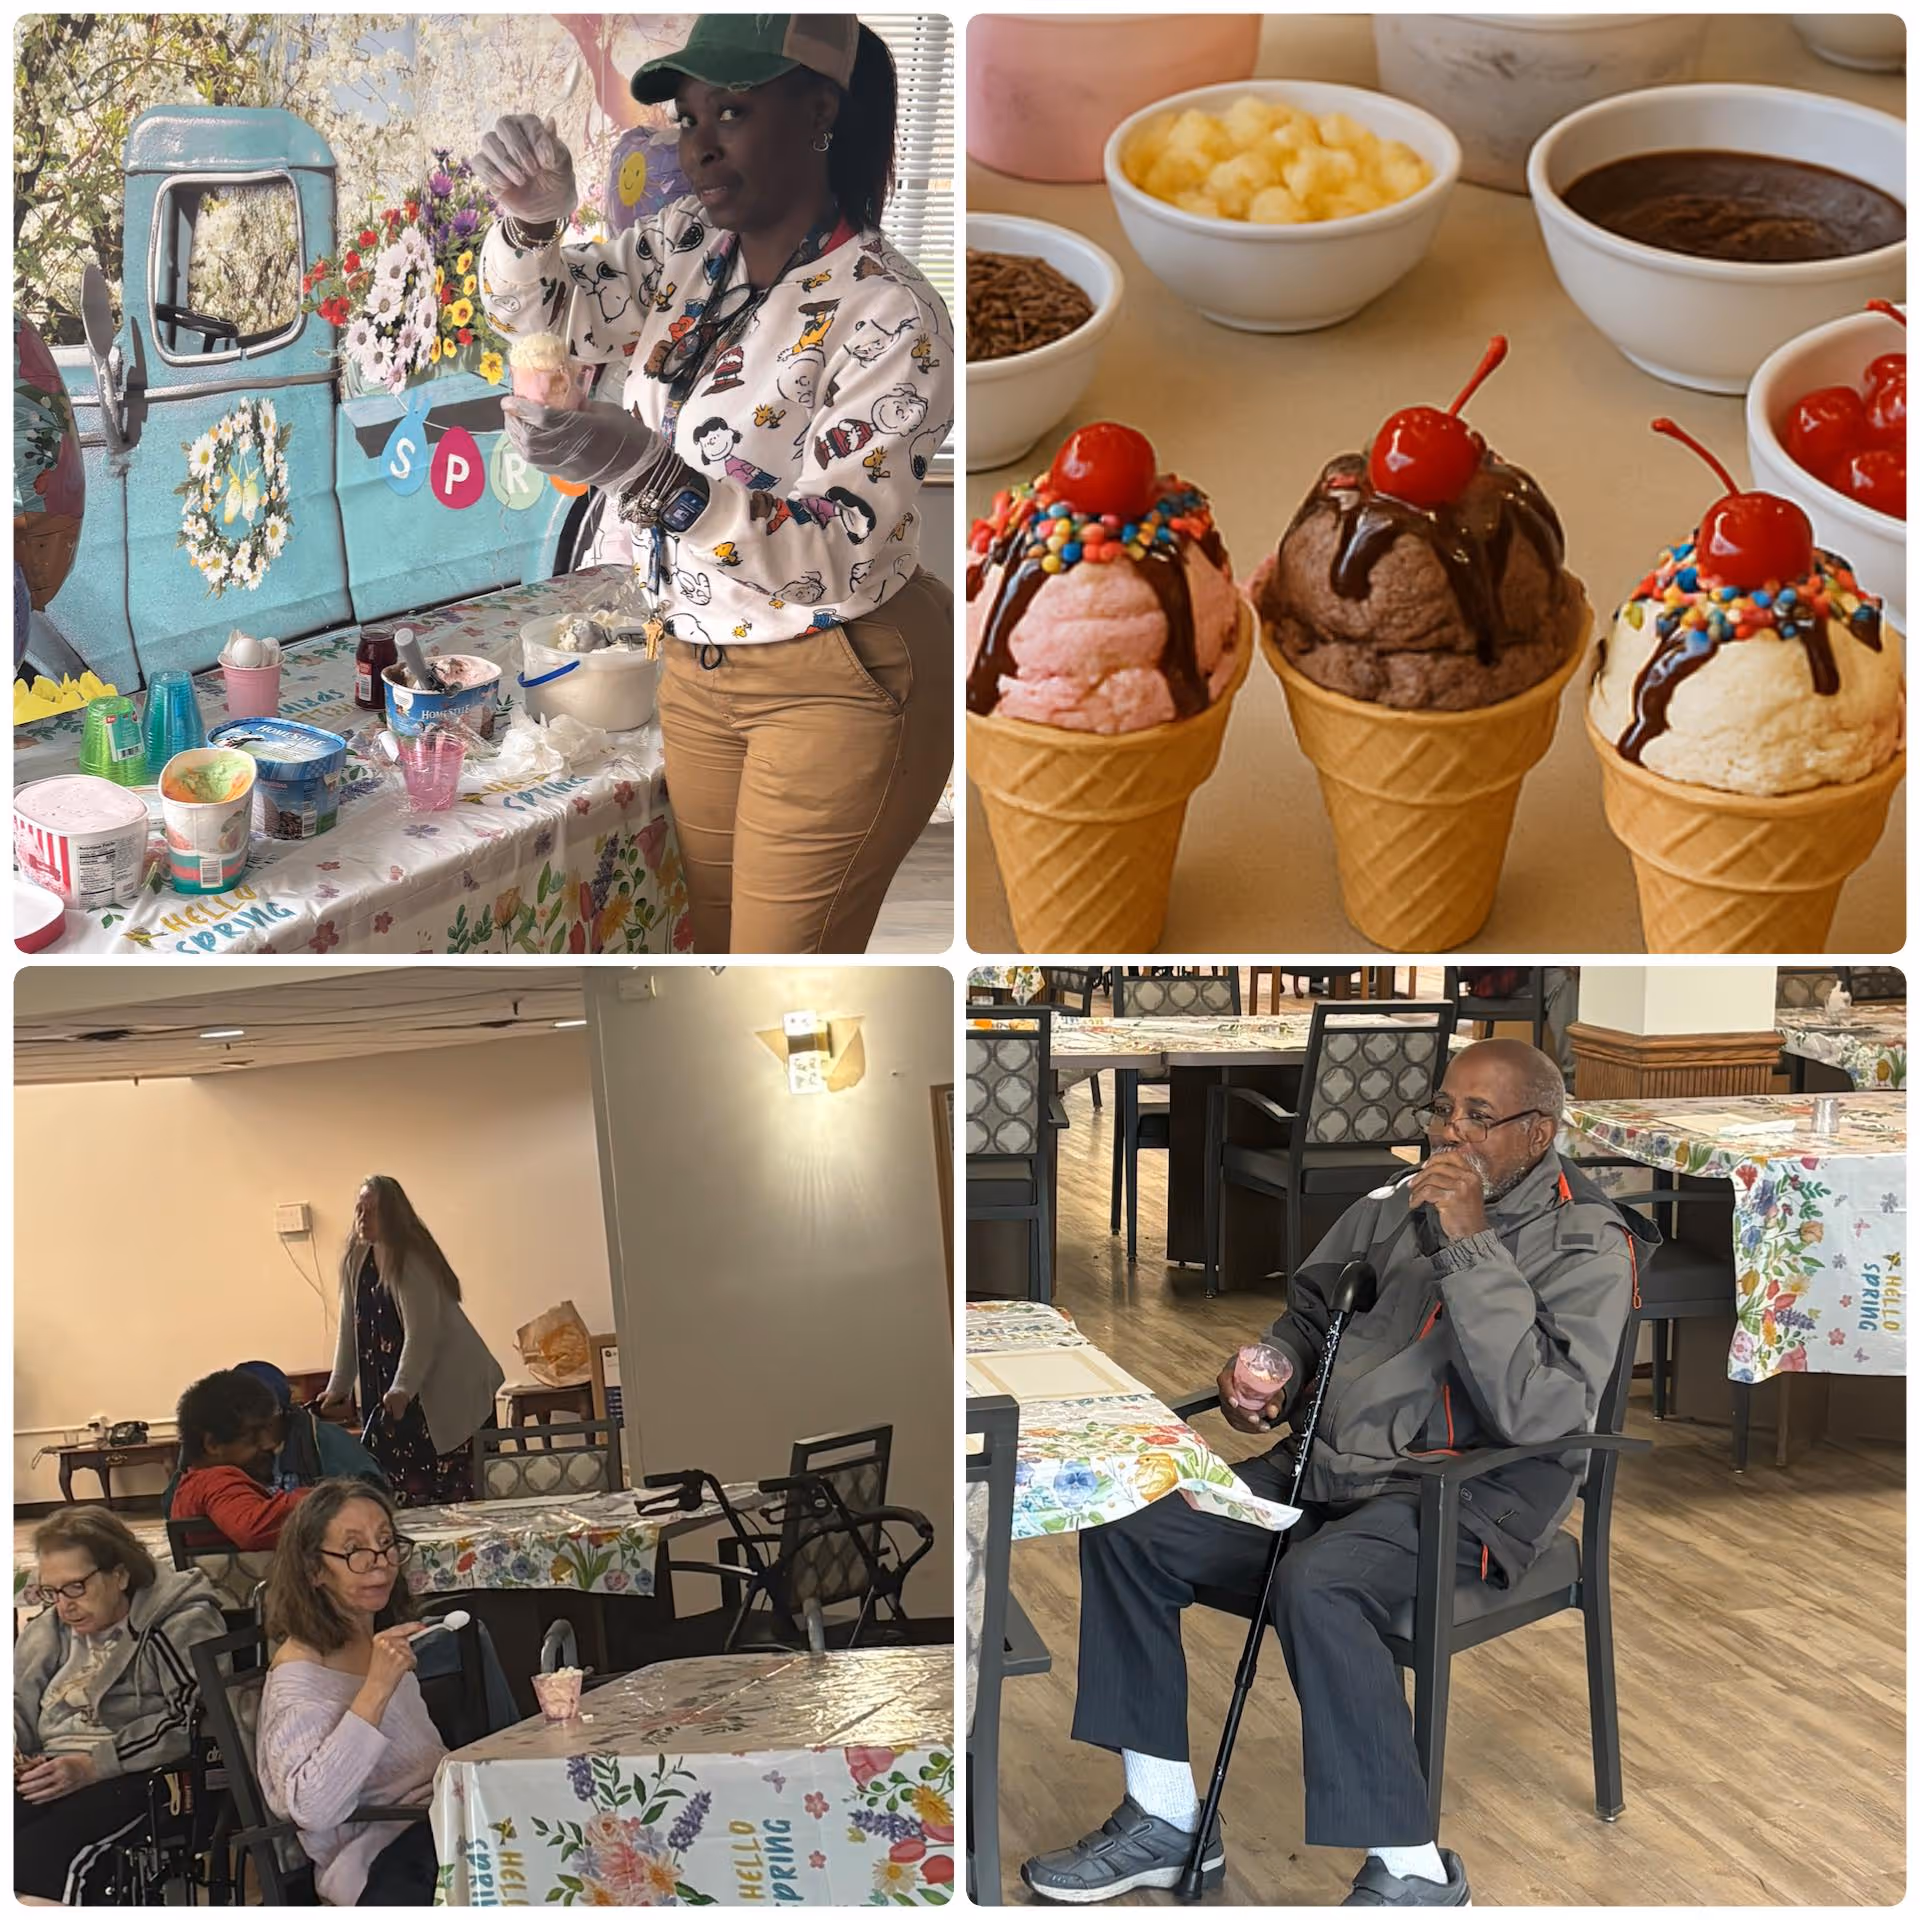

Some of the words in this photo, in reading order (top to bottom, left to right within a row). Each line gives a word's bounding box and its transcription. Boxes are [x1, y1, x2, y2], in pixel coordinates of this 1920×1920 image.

[389, 437, 531, 495] SPR
[255, 724, 327, 747] HOMESTYLE
[159, 884, 258, 933] HELLO
[175, 901, 297, 954] SPRING
[1857, 1262, 1881, 1332] SPRING
[1881, 1275, 1902, 1332] HELLO
[497, 1851, 531, 1906] HELL
[728, 1819, 767, 1900] HELLO
[762, 1817, 805, 1906] PRING
